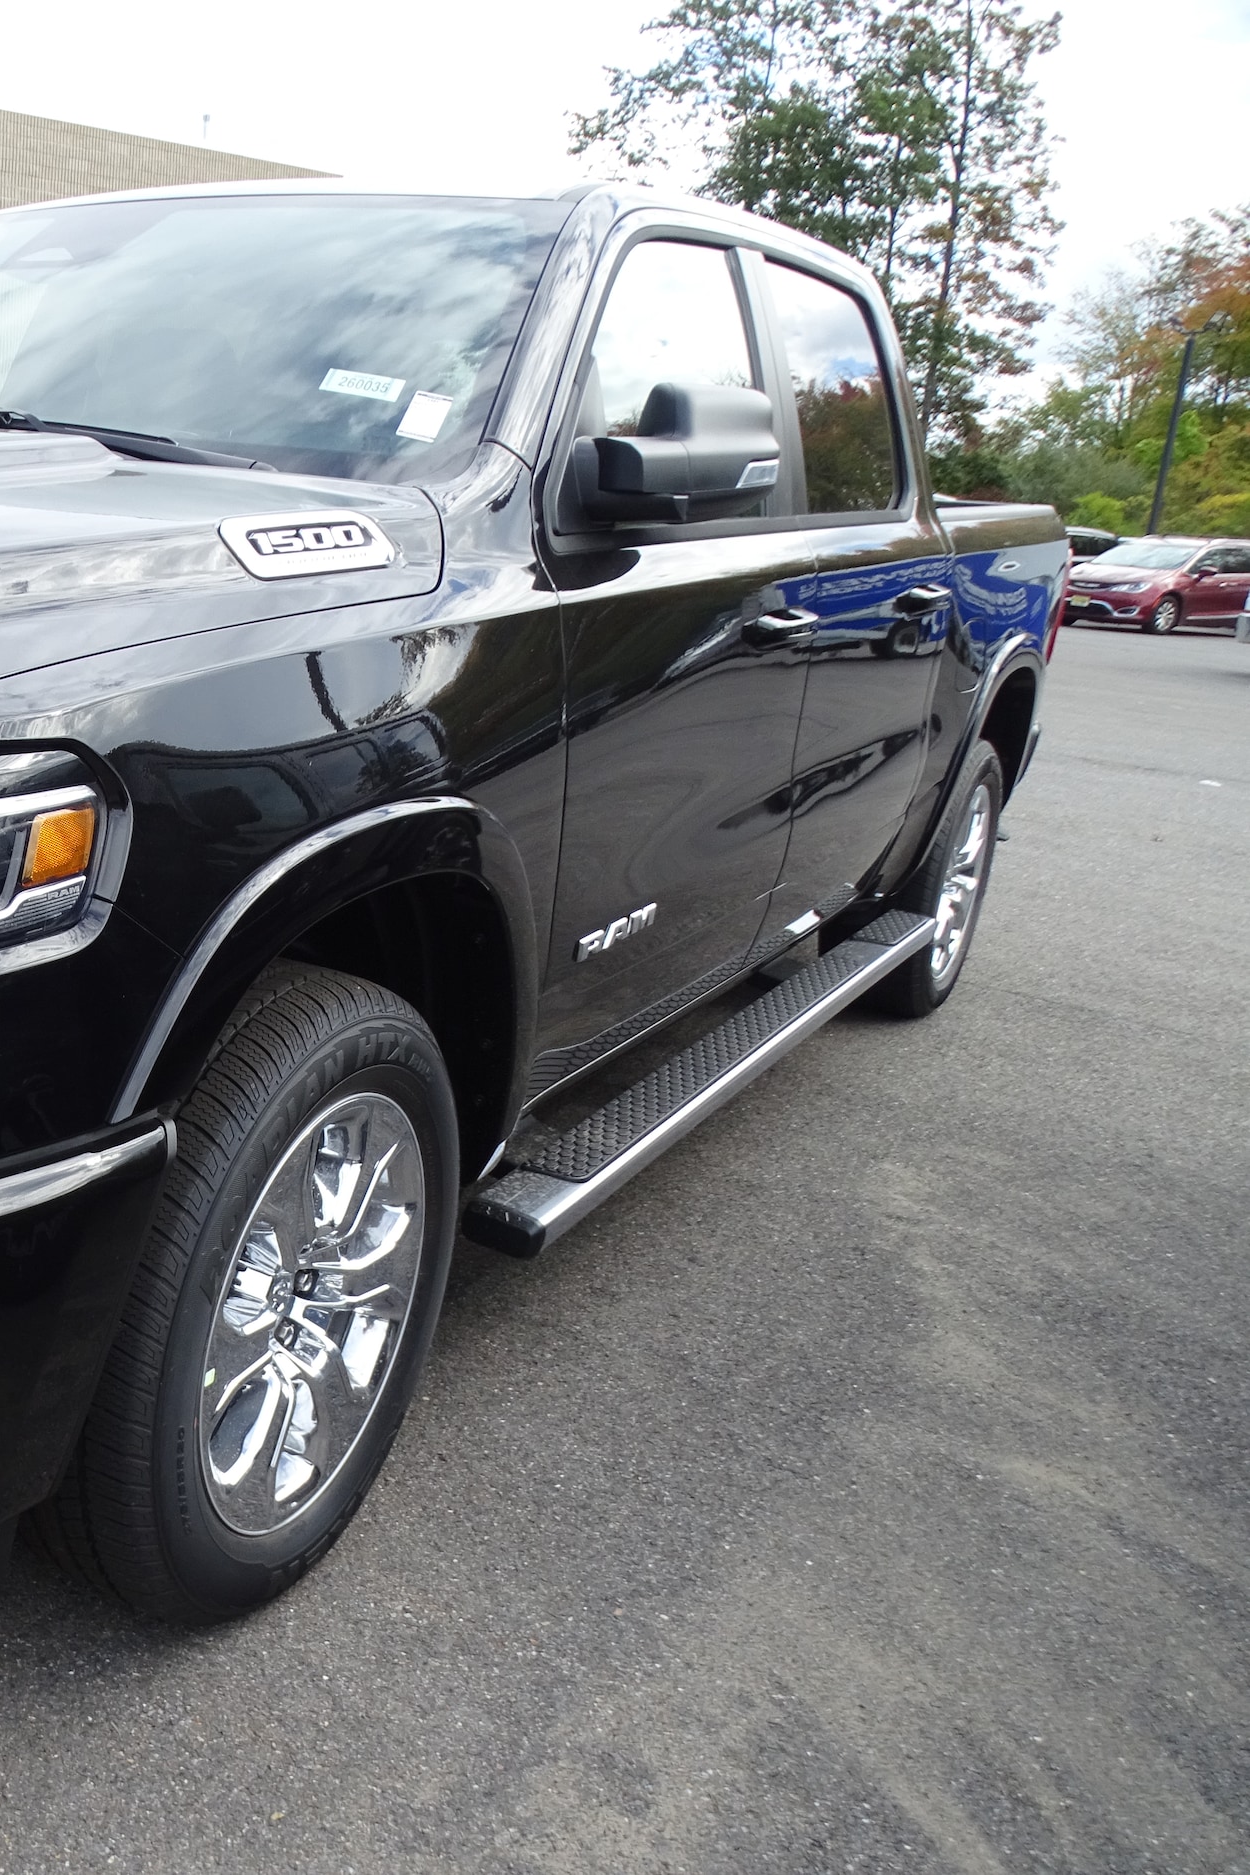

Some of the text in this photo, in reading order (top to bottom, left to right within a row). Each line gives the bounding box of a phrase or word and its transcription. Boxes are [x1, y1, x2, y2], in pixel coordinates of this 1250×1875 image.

[338, 376, 390, 394] 260035
[249, 524, 364, 555] 1500
[572, 903, 657, 962] RAM
[357, 1033, 410, 1066] HTX
